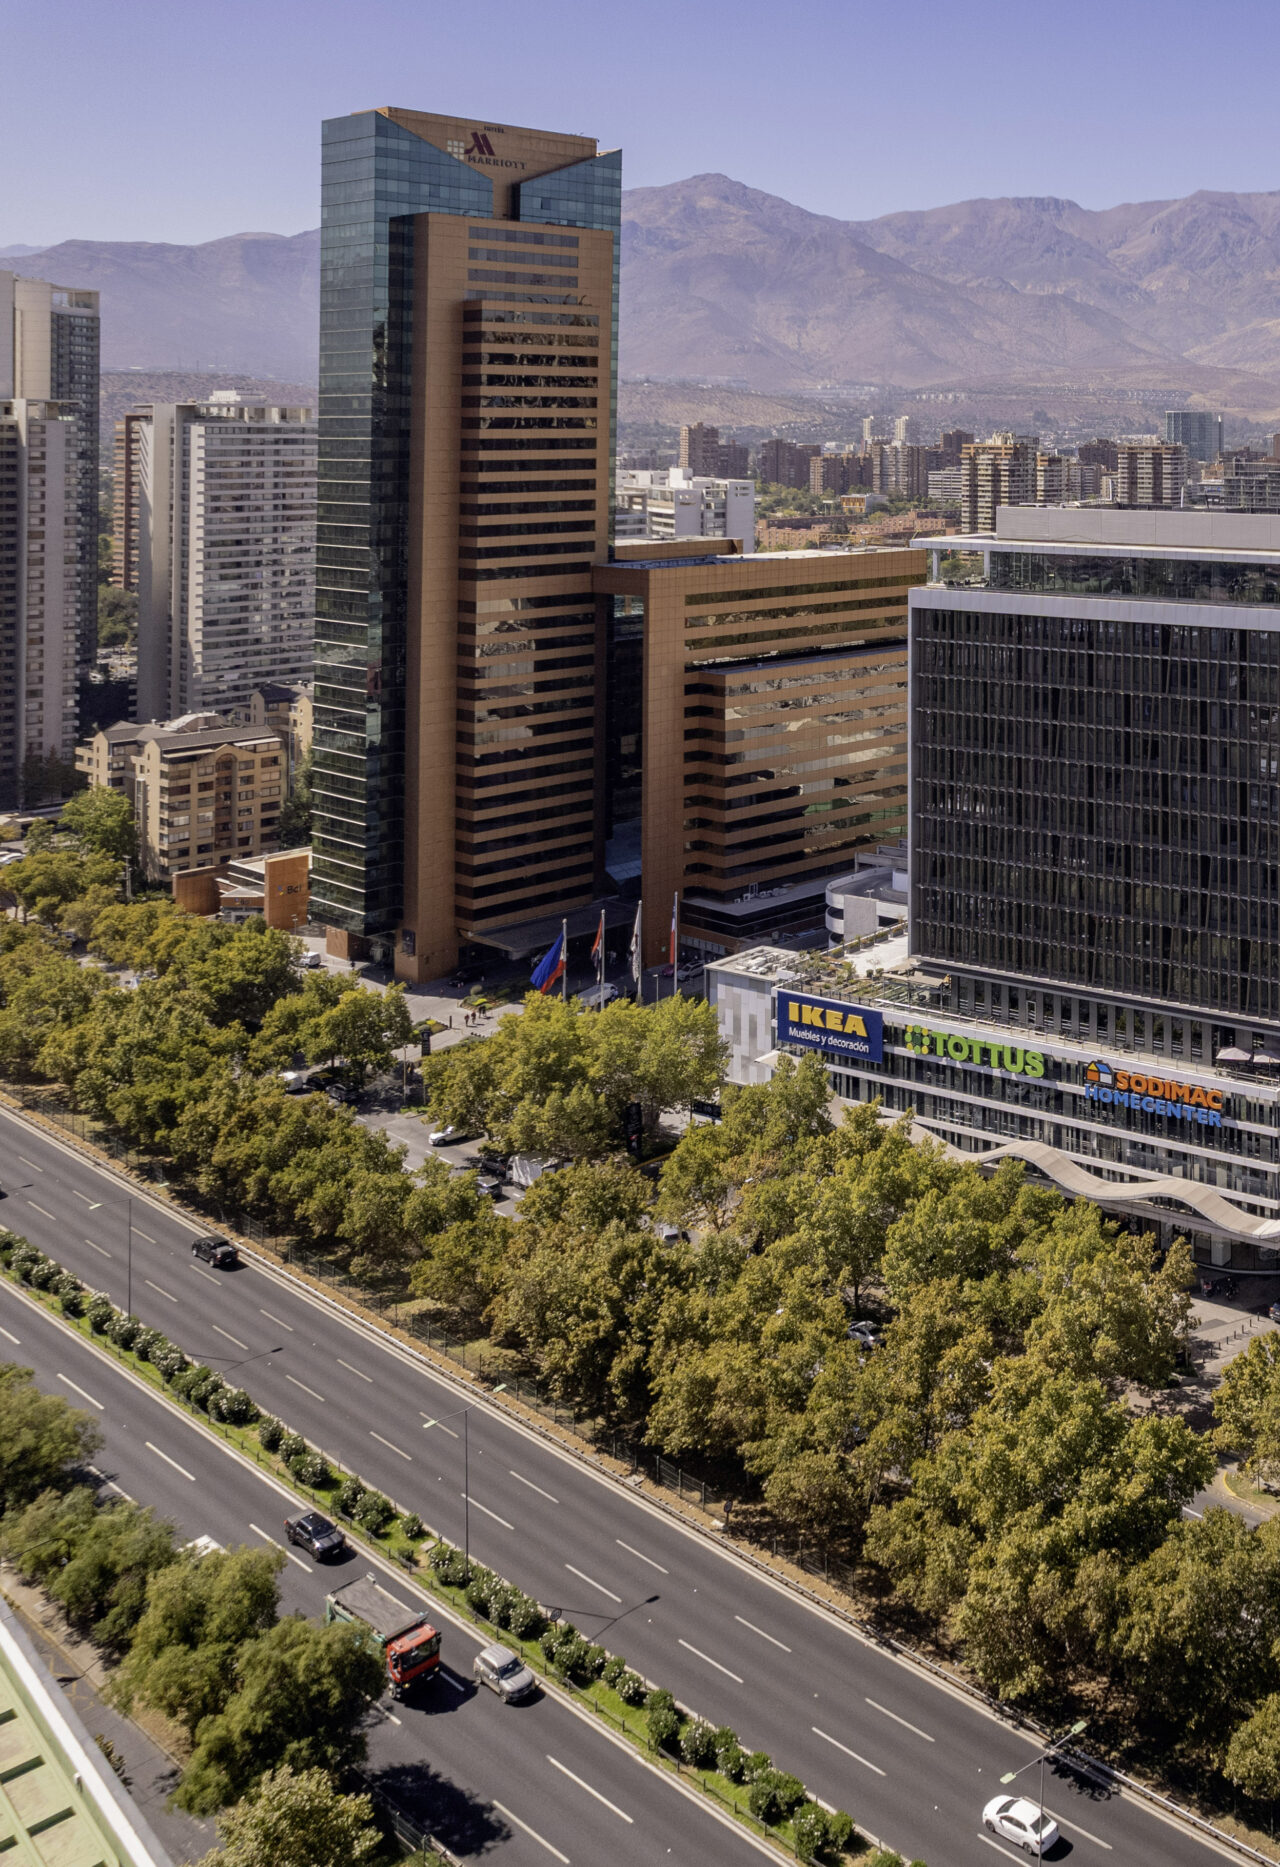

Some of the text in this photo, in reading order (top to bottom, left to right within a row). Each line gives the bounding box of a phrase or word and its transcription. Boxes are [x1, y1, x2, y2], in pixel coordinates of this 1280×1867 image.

[468, 155, 527, 169] MARRIOTT
[788, 1001, 868, 1037] IKEA
[789, 1026, 870, 1053] Muebles y decoración
[932, 1031, 1045, 1078] TOTTUS
[1084, 1083, 1222, 1128] HOMECENTER
[1116, 1070, 1223, 1110] SODIMAC
